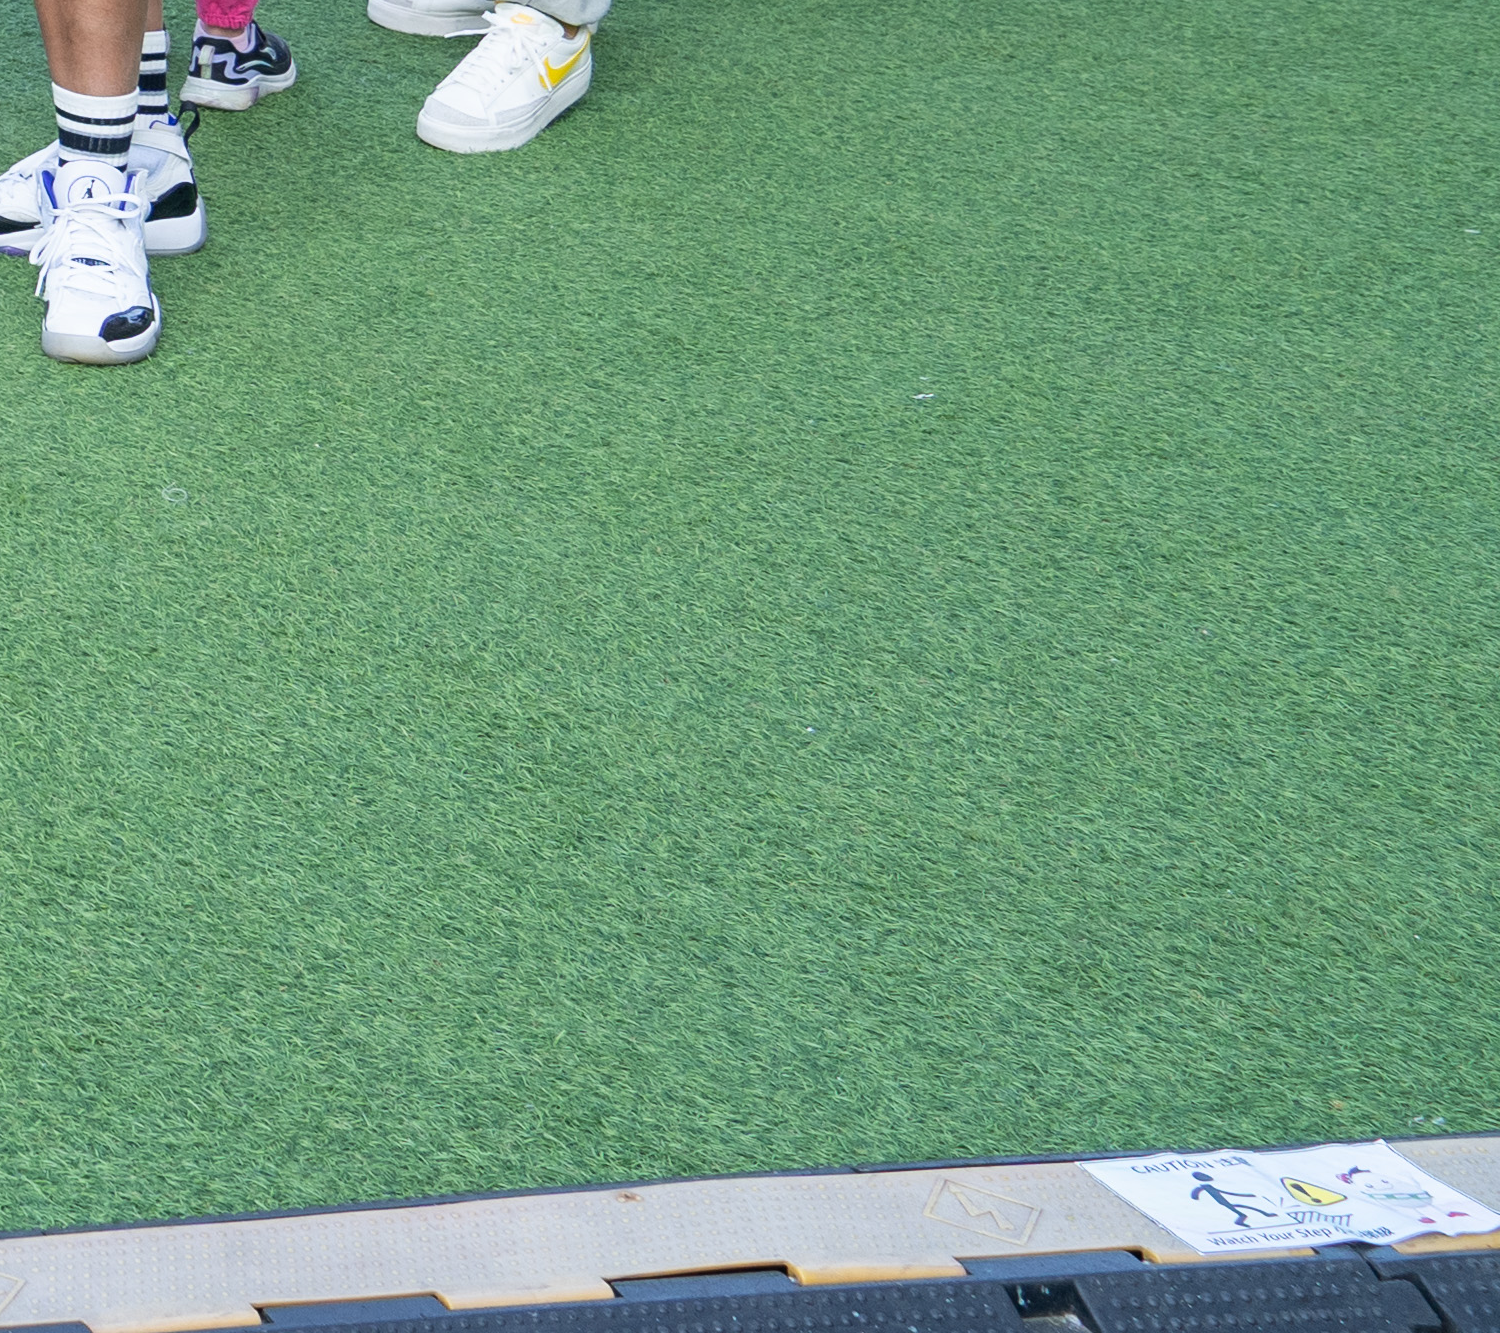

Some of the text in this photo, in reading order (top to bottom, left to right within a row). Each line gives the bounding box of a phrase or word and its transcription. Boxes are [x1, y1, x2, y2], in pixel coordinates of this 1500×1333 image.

[1130, 1158, 1215, 1174] CAUTION
[1207, 1232, 1258, 1247] Watch
[1258, 1230, 1295, 1242] Your
[1296, 1225, 1333, 1241] Step
